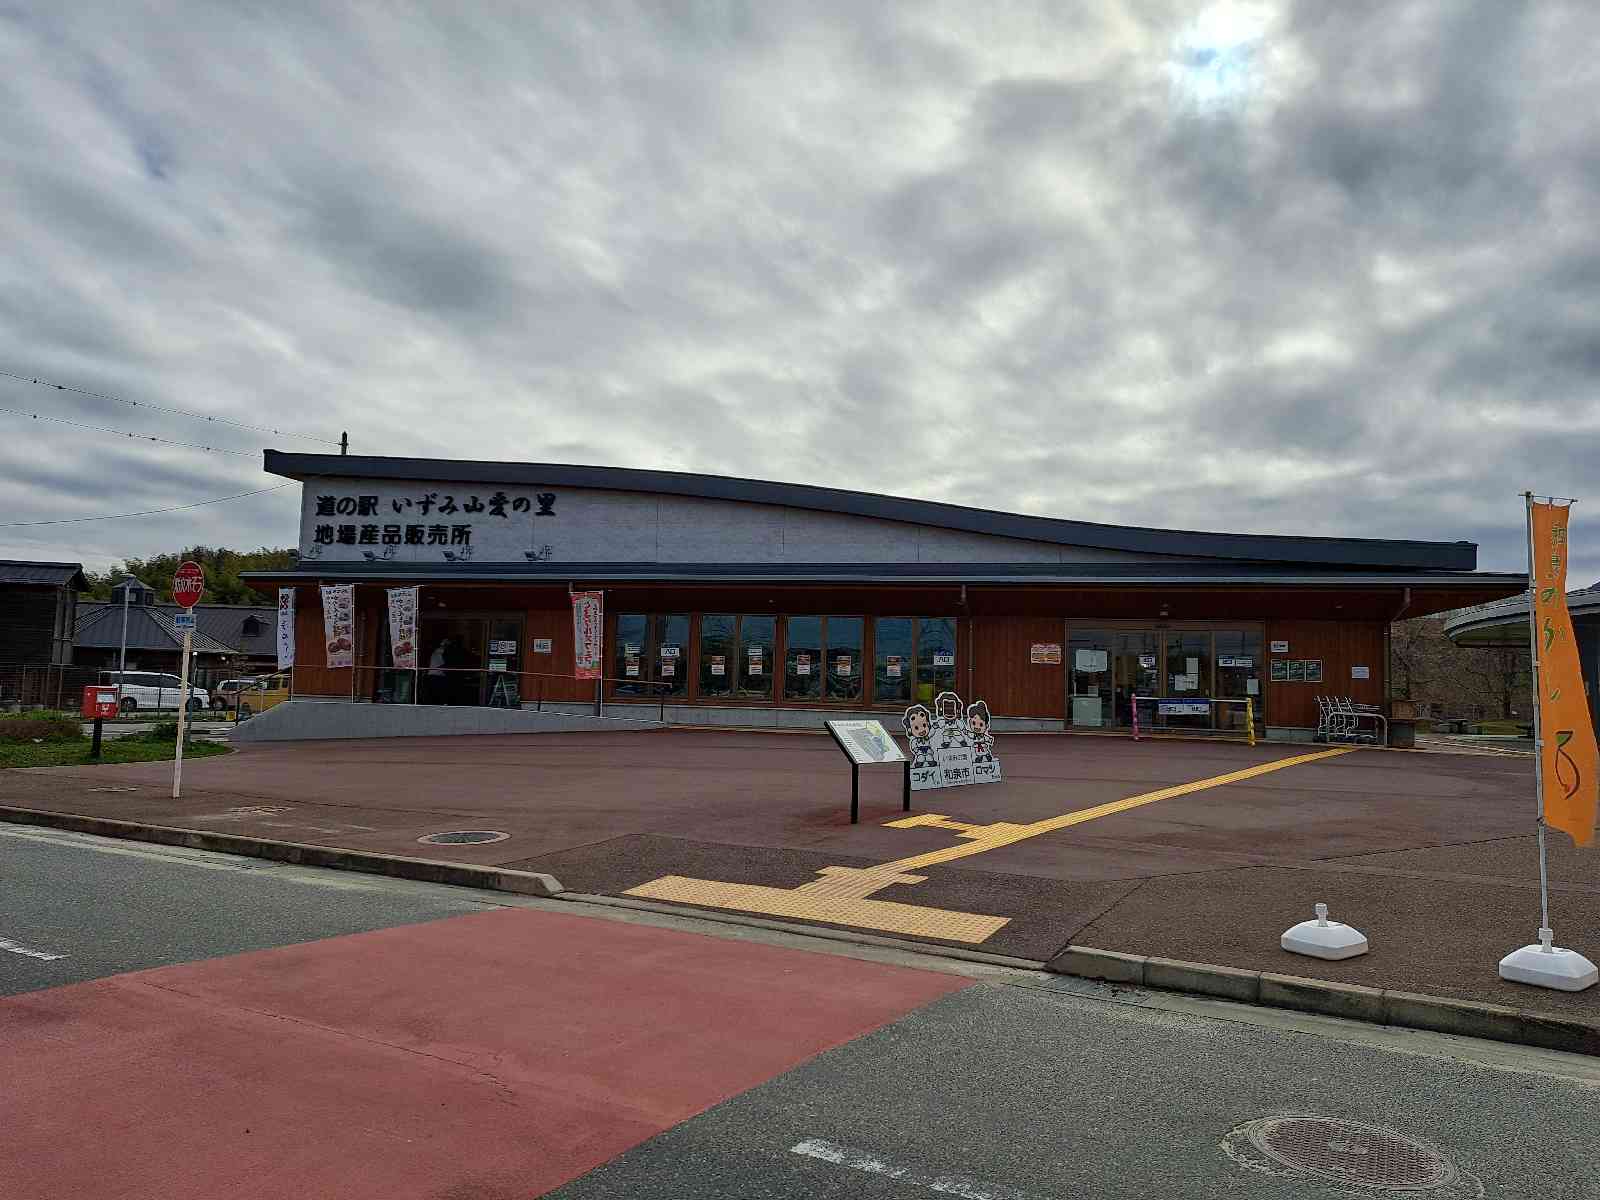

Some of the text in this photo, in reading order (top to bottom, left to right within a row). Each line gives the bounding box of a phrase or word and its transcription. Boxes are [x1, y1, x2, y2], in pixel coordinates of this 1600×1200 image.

[315, 491, 557, 519] 道の駅 いずみ山愛の里
[313, 524, 473, 547] 地場産品販売所
[912, 770, 936, 784] コダイ
[943, 767, 970, 780] 和泉市
